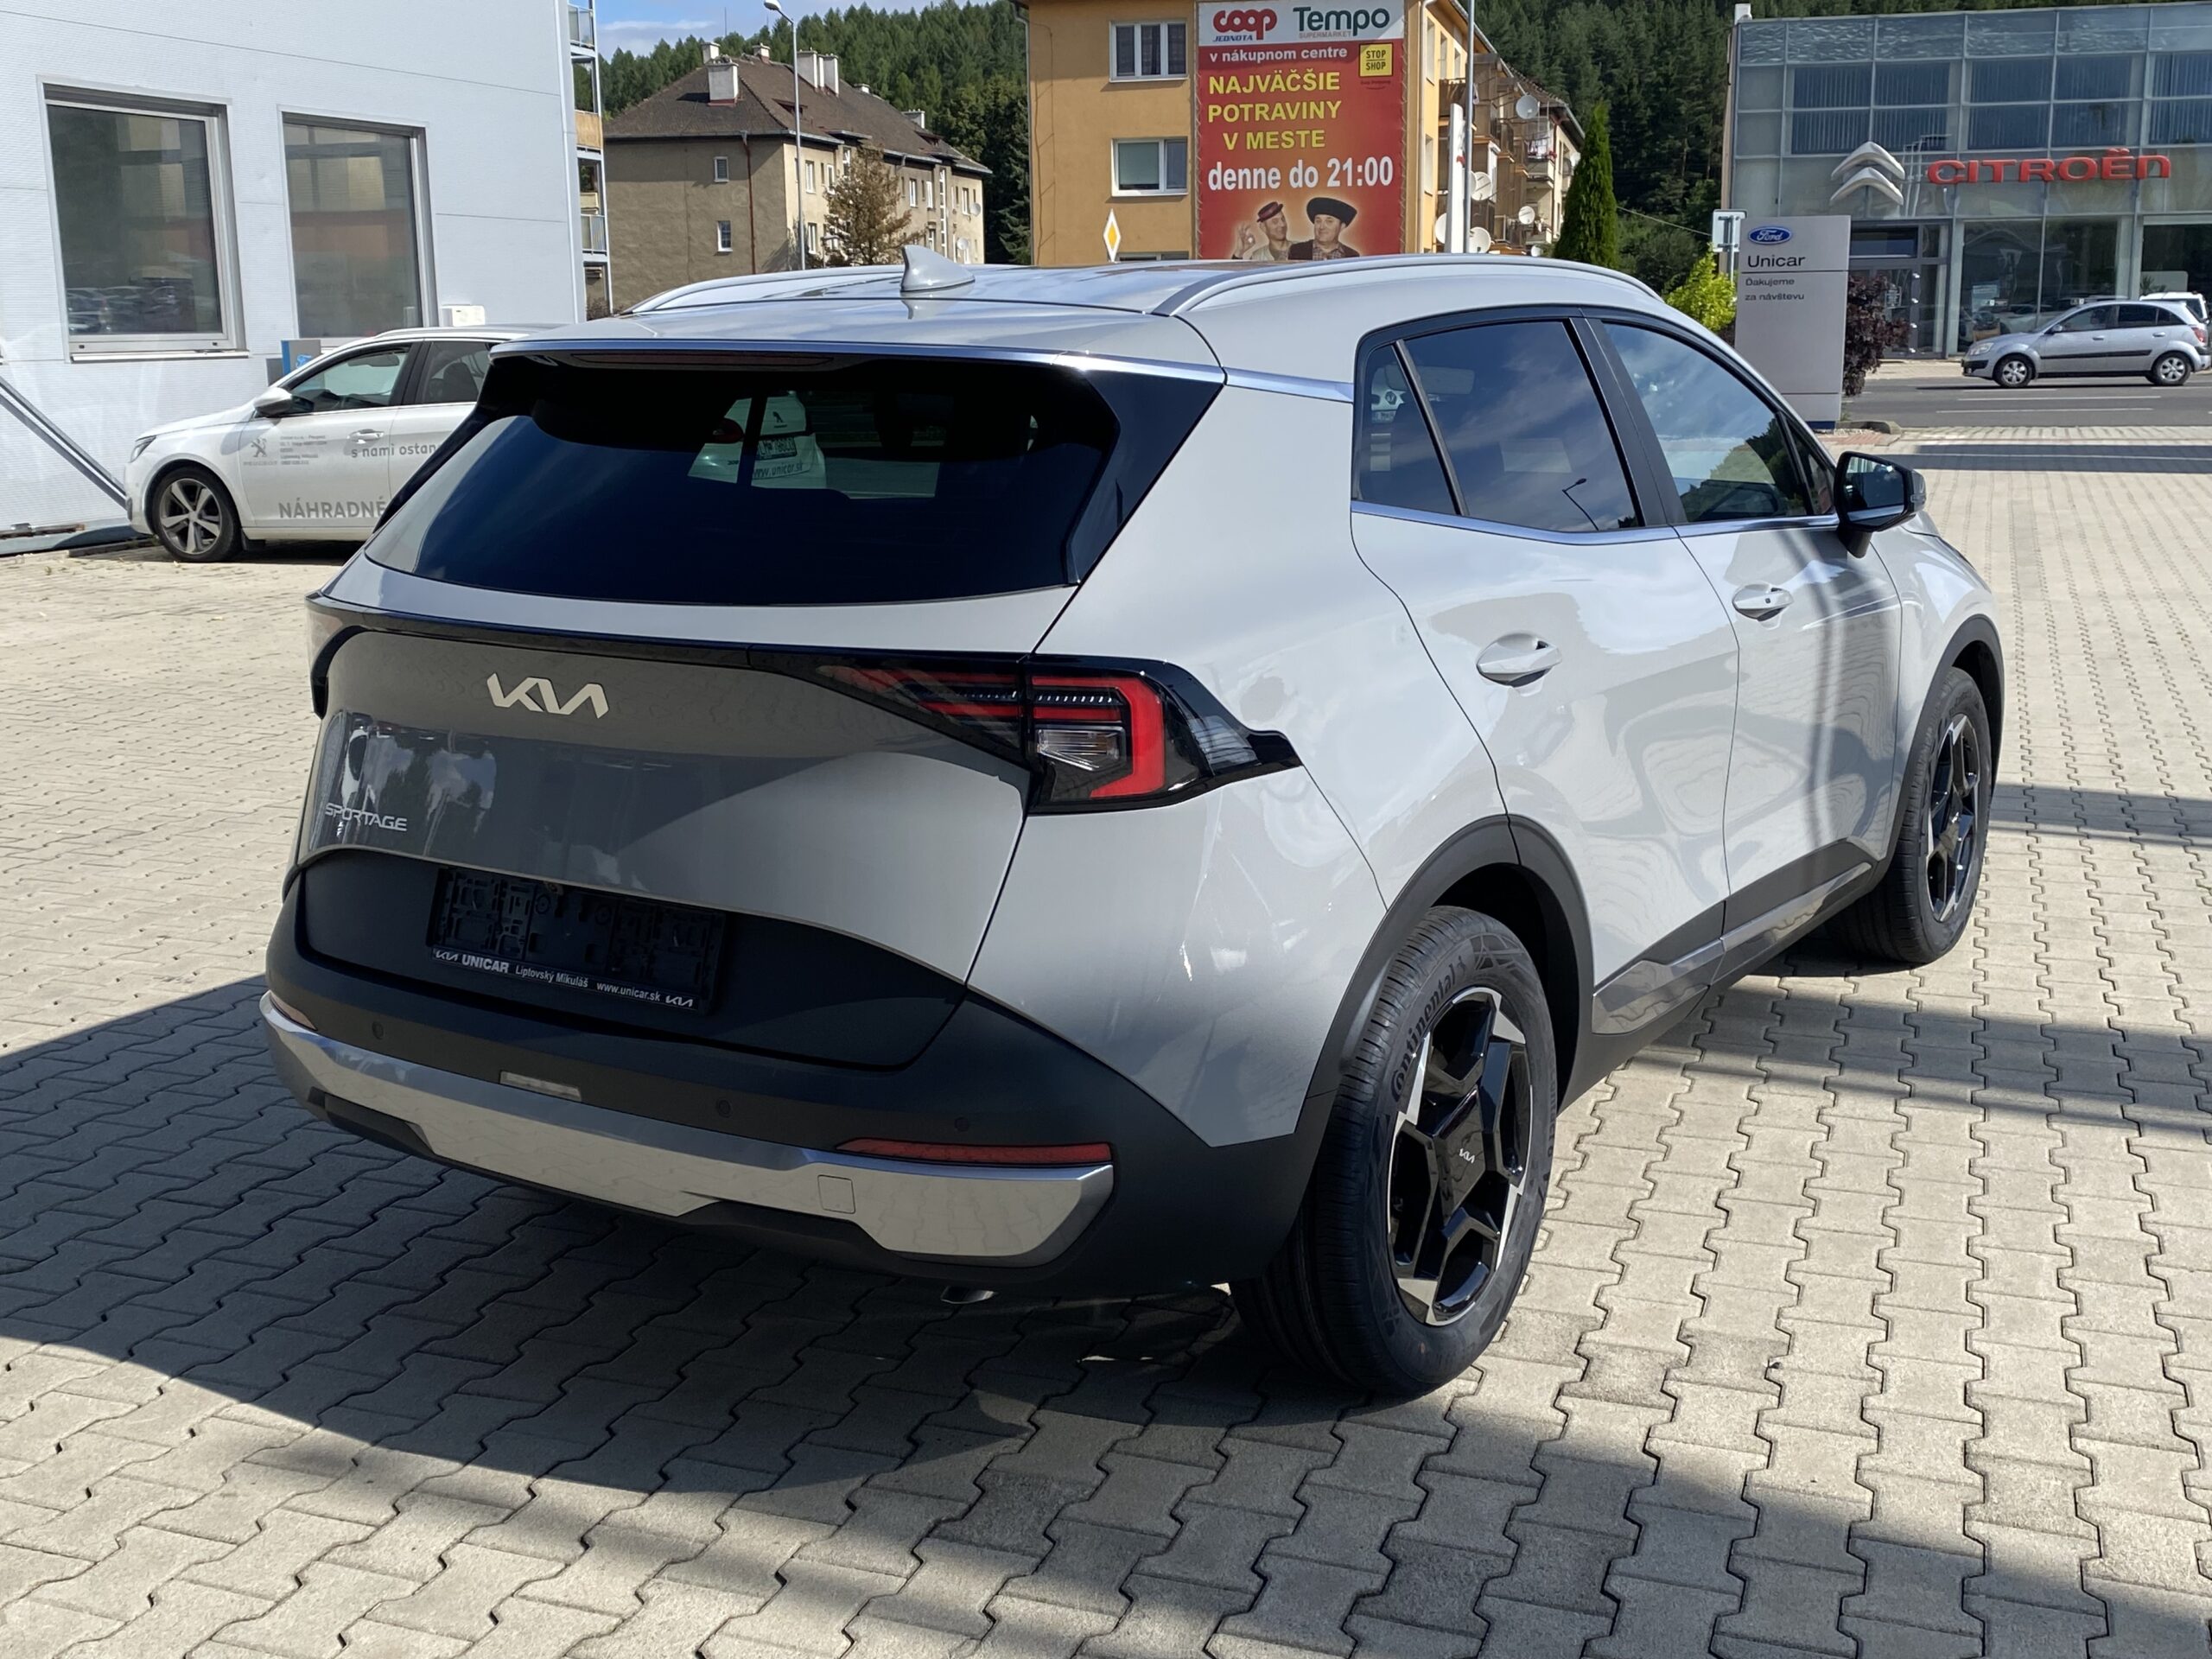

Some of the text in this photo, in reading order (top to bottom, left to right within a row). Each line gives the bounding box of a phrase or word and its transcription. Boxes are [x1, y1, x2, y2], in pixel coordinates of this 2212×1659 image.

[1213, 9, 1277, 40] coop
[1293, 7, 1389, 36] Tempo
[1210, 47, 1347, 63] v nákupnom centre
[1366, 50, 1386, 59] STOP
[1210, 68, 1340, 94] NAJVÄČŠIE
[1208, 100, 1342, 123] POTRAVINY
[1223, 130, 1325, 150] V MESTE
[1208, 156, 1393, 190] denne do 21:00
[1748, 255, 1806, 268] Unicar
[1745, 277, 1795, 287] Ďakujeme
[351, 448, 358, 458] s
[362, 443, 395, 457] nami
[486, 672, 609, 719] KIA
[325, 802, 408, 831] SPORTAGE
[461, 953, 510, 974] UNICAR
[515, 964, 554, 983] Liptovský
[556, 973, 588, 988] Mikuláš
[596, 982, 661, 1001] www.unicar.sk
[1391, 963, 1456, 1103] Continental
[1459, 1148, 1475, 1164] KIA
